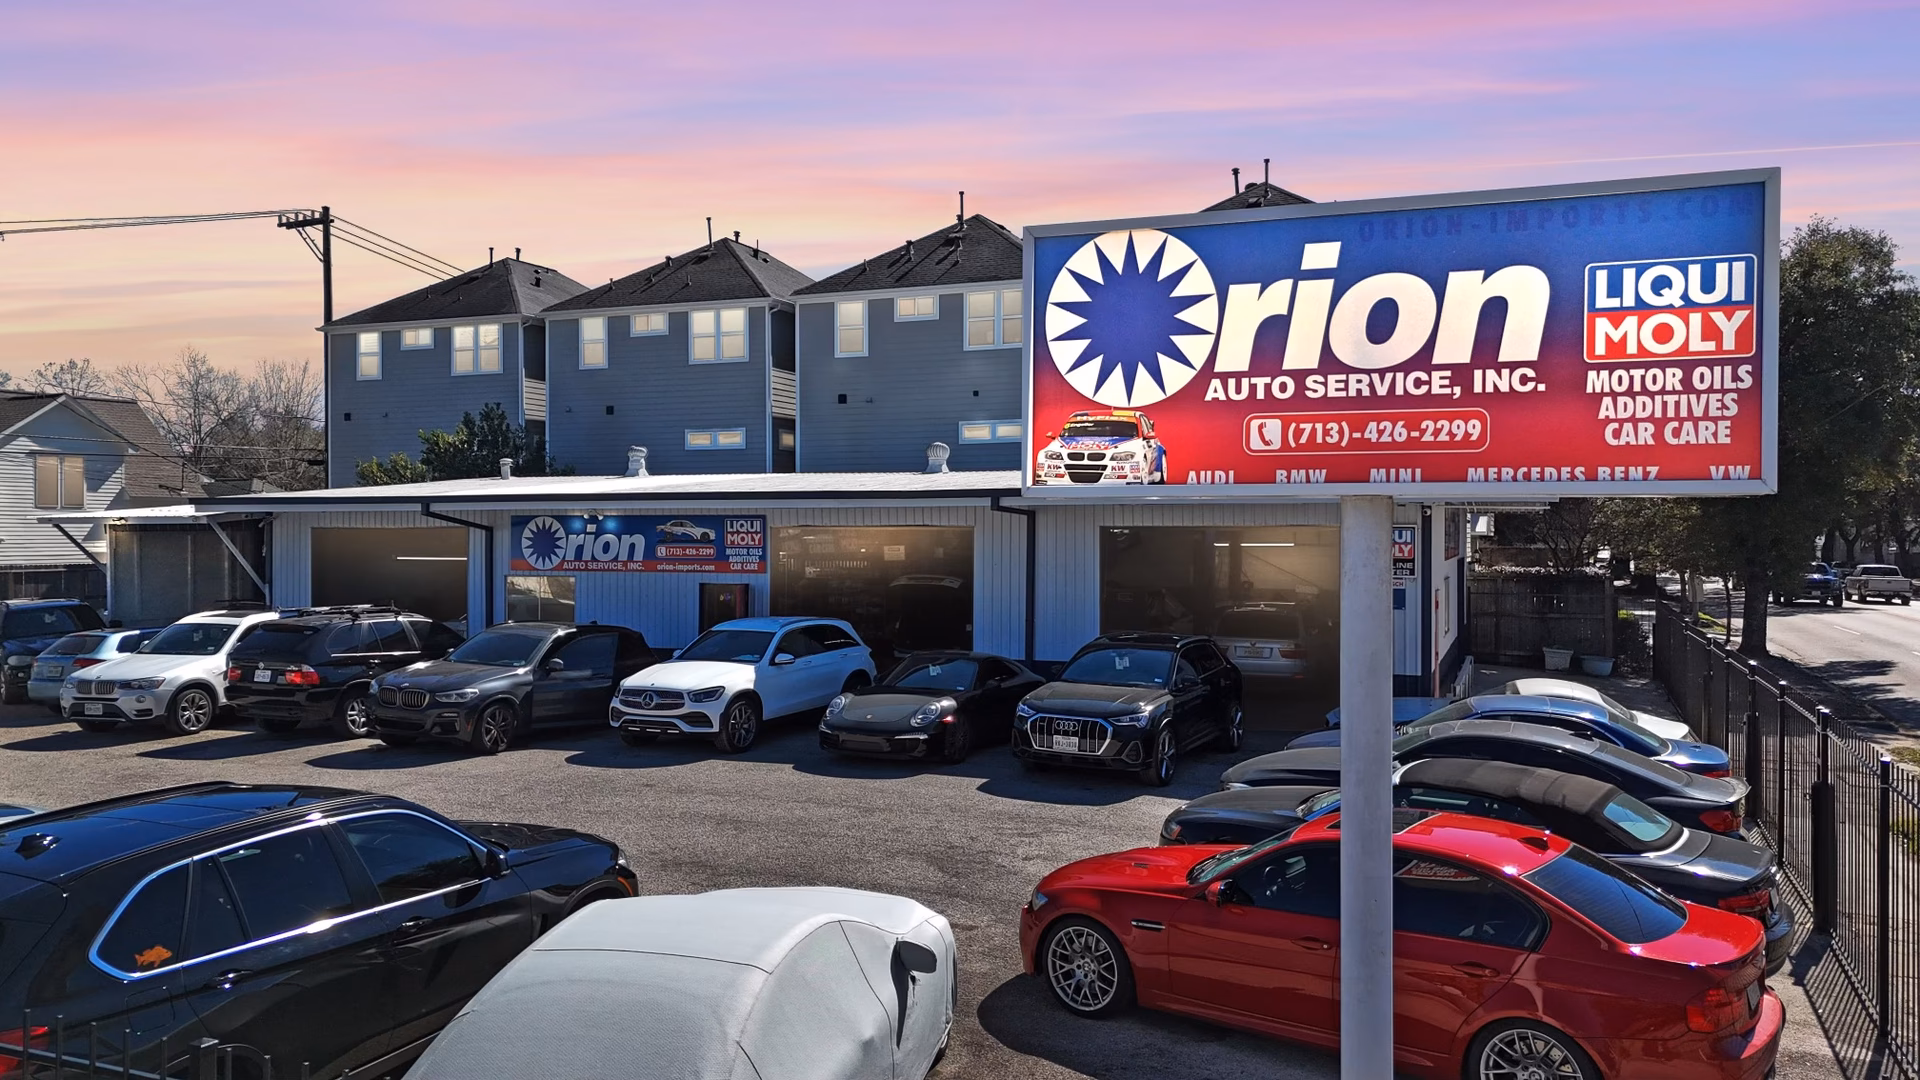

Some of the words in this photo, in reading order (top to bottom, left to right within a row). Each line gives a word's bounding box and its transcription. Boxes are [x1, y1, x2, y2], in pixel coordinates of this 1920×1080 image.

[1594, 261, 1747, 309] LIQUI
[1045, 229, 1550, 408] Orion
[1594, 309, 1752, 356] MOLY
[1204, 375, 1296, 401] AUTO
[1304, 370, 1462, 400] SERVICE,
[1473, 367, 1546, 394] INC.
[1585, 367, 1684, 394] MOTOR
[1692, 364, 1753, 391] OILS
[1597, 392, 1739, 420] ADDITIVES
[1287, 419, 1482, 448] (713)-426-2299
[1604, 422, 1656, 446] CAR
[1664, 420, 1732, 445] CARE
[1186, 469, 1235, 485] AUDI
[1275, 468, 1328, 484] BMW
[1369, 467, 1422, 483] MINI
[1466, 465, 1587, 482] MERCEDES
[1597, 465, 1660, 481] BENZ
[1709, 465, 1751, 480] VW
[726, 520, 760, 532] LIQUI
[521, 516, 646, 571] Orion
[727, 533, 762, 545] MOLY
[1393, 530, 1412, 543] UI
[666, 548, 714, 556] (713)-426-2299
[725, 548, 748, 556] MOTOR
[728, 555, 760, 563] ADDITIVES
[1393, 544, 1412, 557] LY
[563, 562, 586, 570] AUTO
[587, 562, 626, 571] SERVICE,
[627, 562, 645, 570] INC.
[656, 563, 716, 572] orion-imports.com
